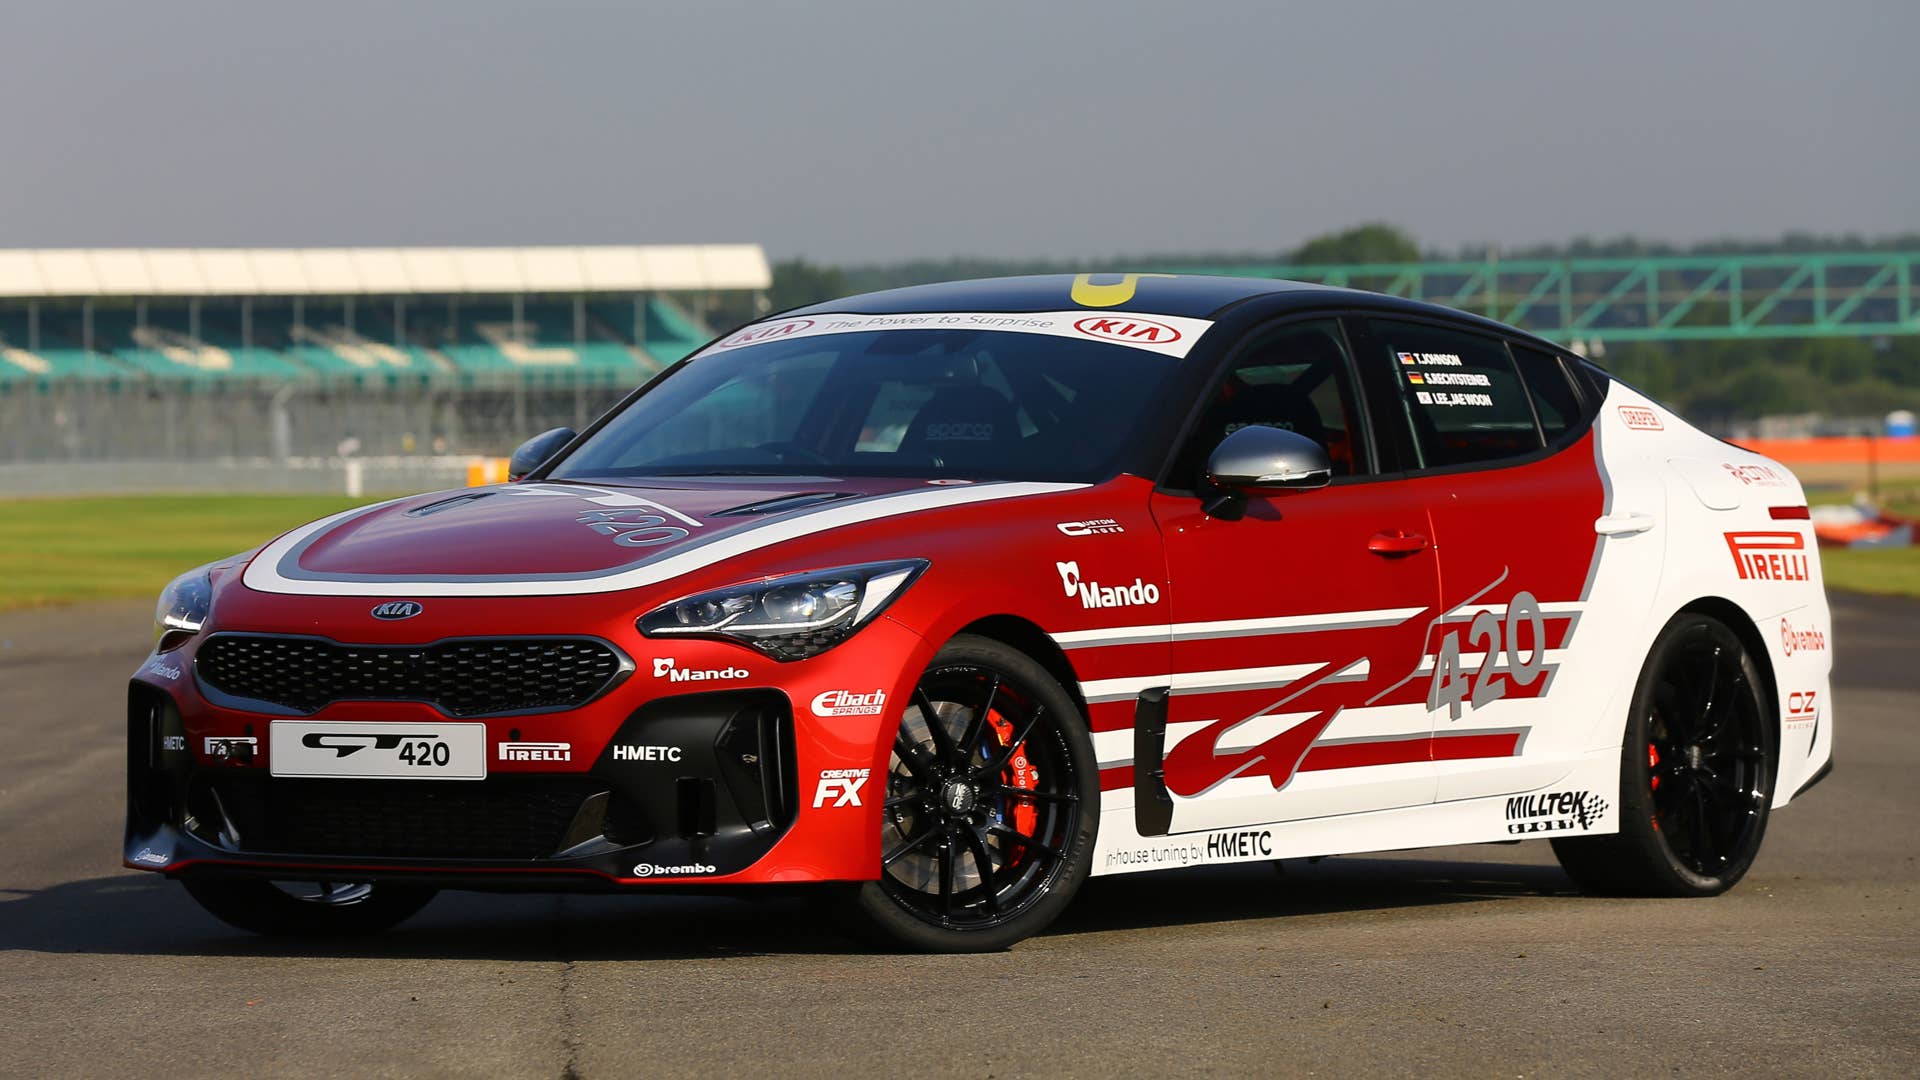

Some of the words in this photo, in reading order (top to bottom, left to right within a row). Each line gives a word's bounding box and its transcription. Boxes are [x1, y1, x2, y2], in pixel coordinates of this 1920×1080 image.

[824, 320, 862, 330] The
[866, 315, 934, 326] Power
[938, 315, 961, 324] to
[965, 315, 1054, 328] Surprise
[1089, 319, 1161, 341] KIA
[1622, 410, 1660, 426] DRAPER
[576, 508, 690, 547] 420
[1723, 531, 1810, 581] PIRELLI
[1078, 578, 1160, 609] Mando
[376, 603, 413, 615] KIA
[1426, 591, 1546, 722] 420
[669, 667, 750, 682] Mando
[811, 688, 886, 717] Eibach
[832, 706, 878, 715] SPRINGS
[1788, 691, 1816, 713] OZ
[399, 742, 450, 767] 420
[498, 742, 571, 761] PIRELLI
[613, 745, 682, 762] HMETC
[820, 768, 871, 779] CREATIVE
[812, 778, 869, 808] FX
[1510, 820, 1573, 834] SPORT
[1105, 847, 1149, 866] in-house
[1152, 844, 1188, 864] tuning
[1190, 842, 1204, 863] by
[1207, 831, 1272, 858] HMETC
[654, 863, 717, 875] brembo
